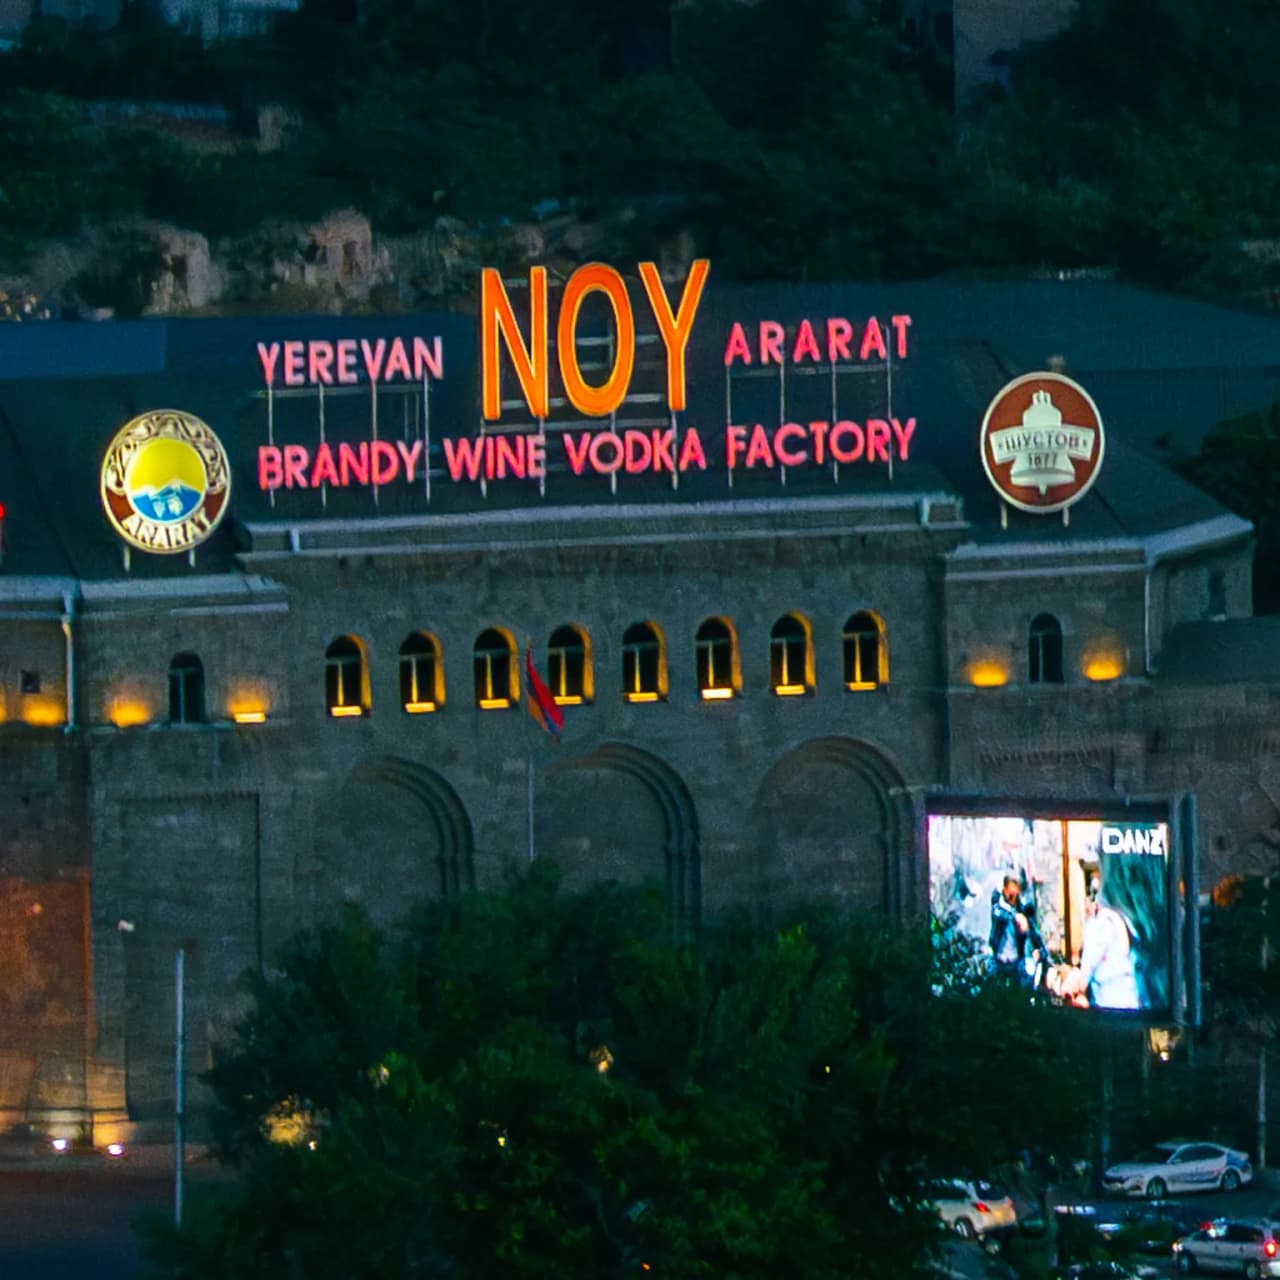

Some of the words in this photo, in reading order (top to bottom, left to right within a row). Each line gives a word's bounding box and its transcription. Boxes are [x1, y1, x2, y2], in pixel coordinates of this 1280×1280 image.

[257, 336, 443, 385] YEREVAN
[481, 258, 710, 420] NOY
[724, 314, 912, 365] ARARAT
[258, 439, 422, 490] BRANDY
[443, 434, 546, 481] WINE
[563, 427, 706, 474] VODKA
[726, 417, 917, 470] FACTORY
[120, 507, 212, 547] ARARAT
